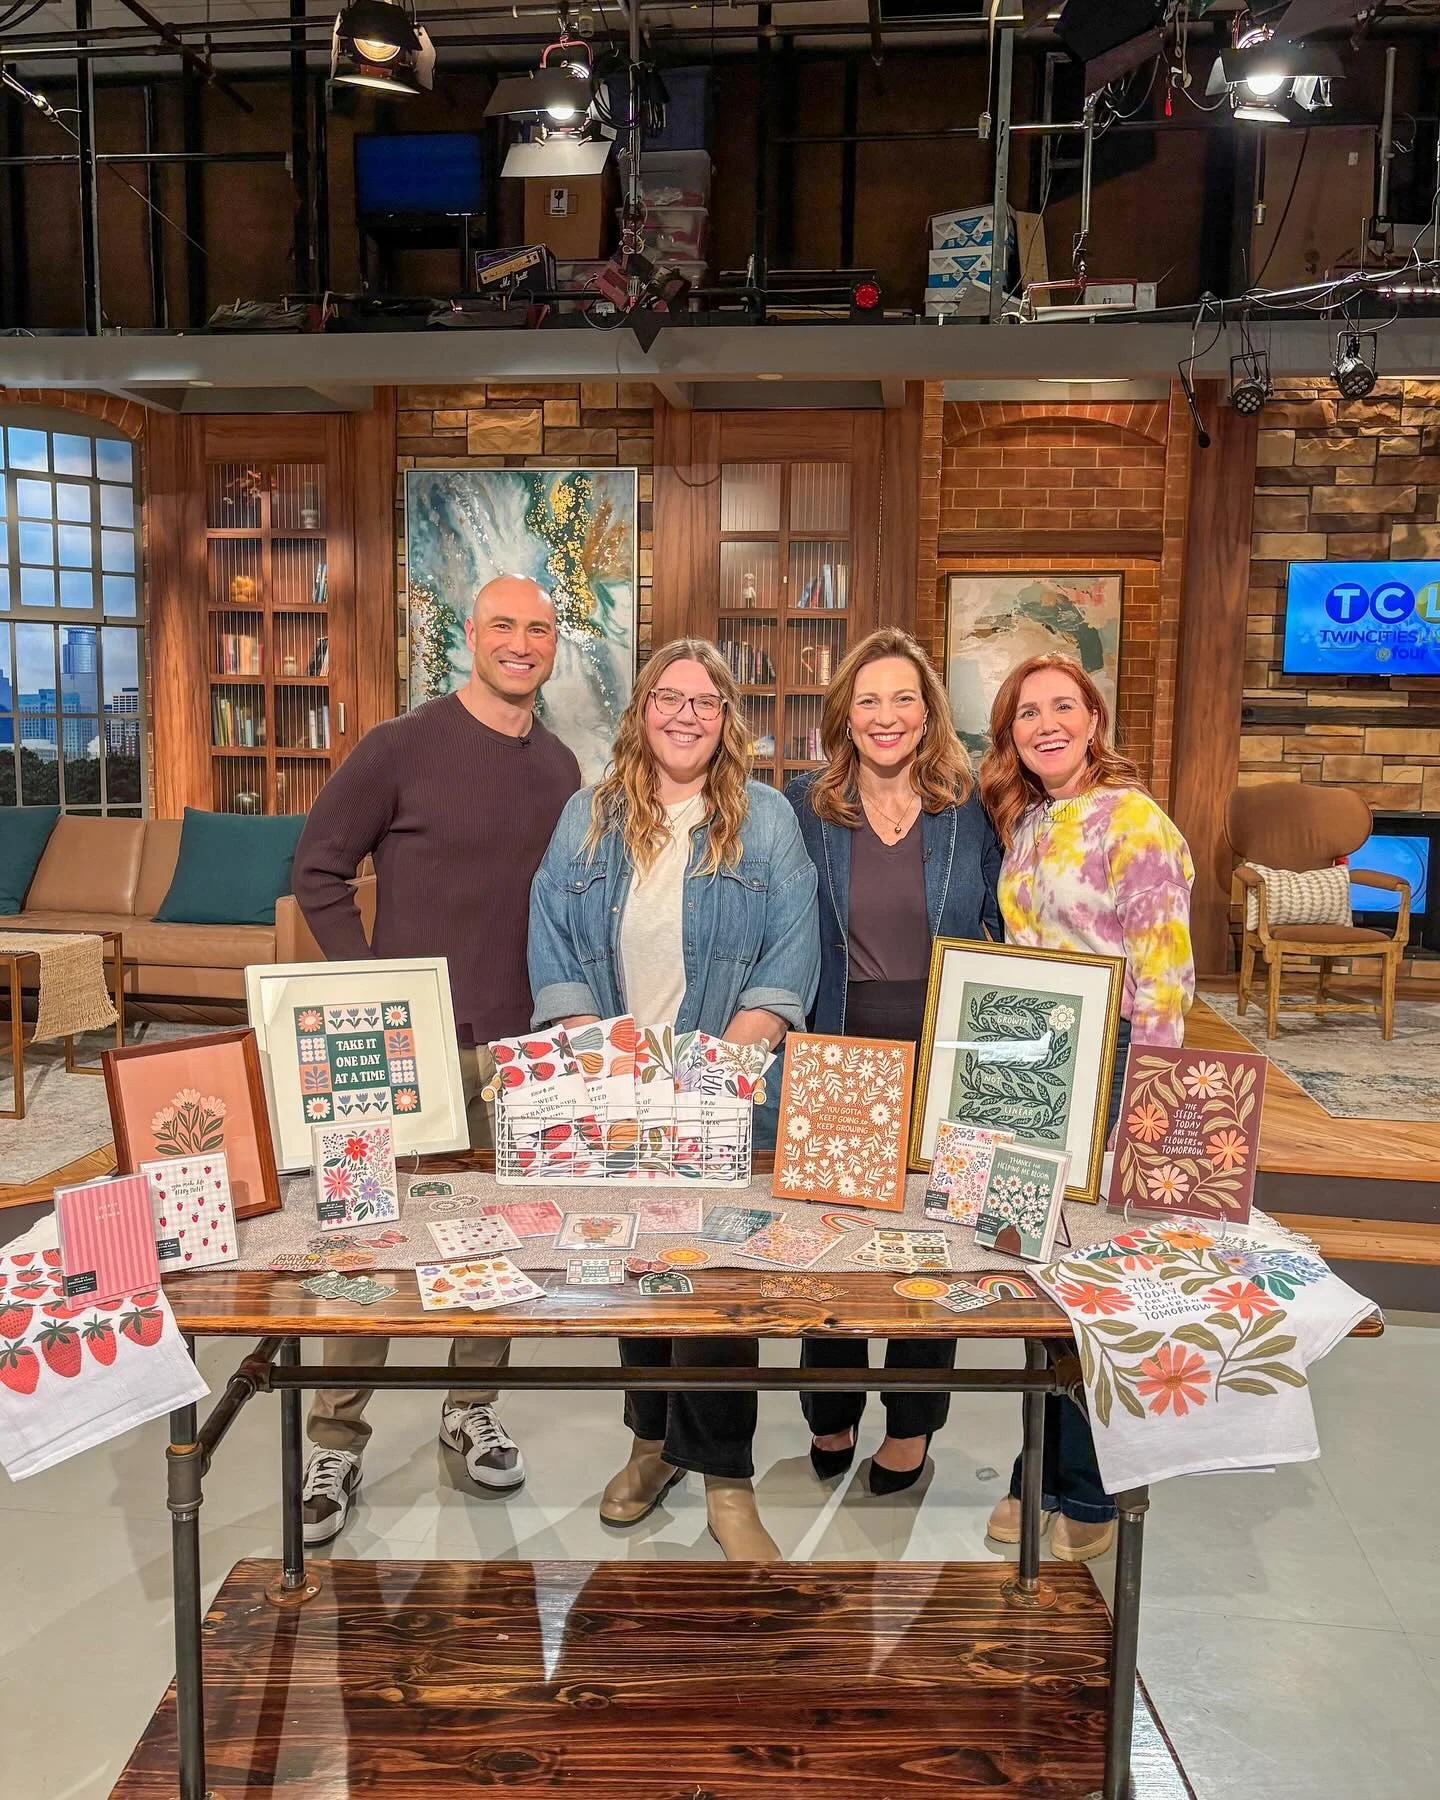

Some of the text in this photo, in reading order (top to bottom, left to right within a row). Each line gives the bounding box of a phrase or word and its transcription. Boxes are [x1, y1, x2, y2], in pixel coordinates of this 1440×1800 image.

[998, 1015, 1030, 1026] GROWTH
[336, 1038, 377, 1051] TAKE IT
[336, 1054, 380, 1067] ONE DAY
[335, 1070, 386, 1084] AT A TIME
[984, 1075, 1001, 1084] NOT
[826, 1106, 862, 1116] YOU GOTTA
[1004, 1106, 1033, 1116] LINEAR
[1184, 1103, 1198, 1111] THE
[819, 1114, 837, 1122] KEEP
[837, 1116, 859, 1125] GOING
[1173, 1109, 1198, 1120] SEEDS
[816, 1122, 869, 1134] KEEP GROWING
[1175, 1119, 1200, 1129] TODAY
[1164, 1136, 1197, 1146] FLOWERS
[1161, 1144, 1204, 1156] TOMORROW
[1009, 1157, 1032, 1168] THANKS
[1124, 1281, 1162, 1293] SEEDS
[1132, 1287, 1177, 1300] TODAY
[1137, 1299, 1189, 1311] FLOWERS
[1138, 1303, 1211, 1320] TOMORROW
